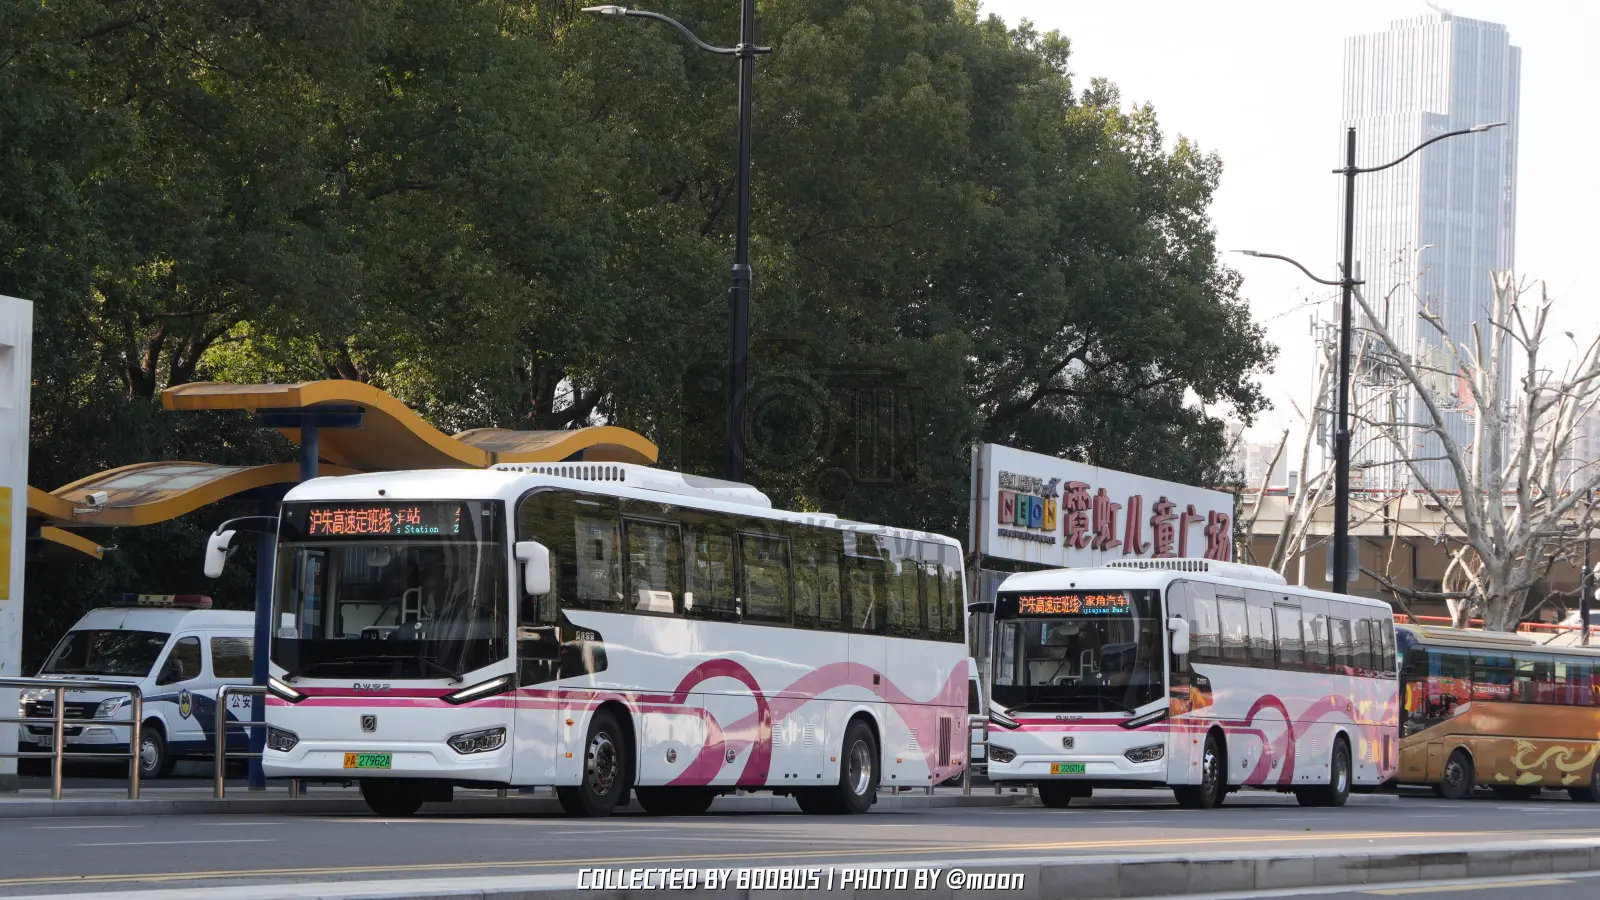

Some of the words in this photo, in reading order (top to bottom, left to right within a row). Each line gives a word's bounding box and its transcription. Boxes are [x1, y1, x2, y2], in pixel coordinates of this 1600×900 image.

[309, 507, 391, 535] 沪朱高速定班线
[1000, 494, 1056, 528] NEON
[1062, 481, 1231, 562] 霓虹儿童广场
[404, 524, 439, 534] Station
[1083, 594, 1130, 607] 家角汽车
[231, 694, 252, 709] 公安
